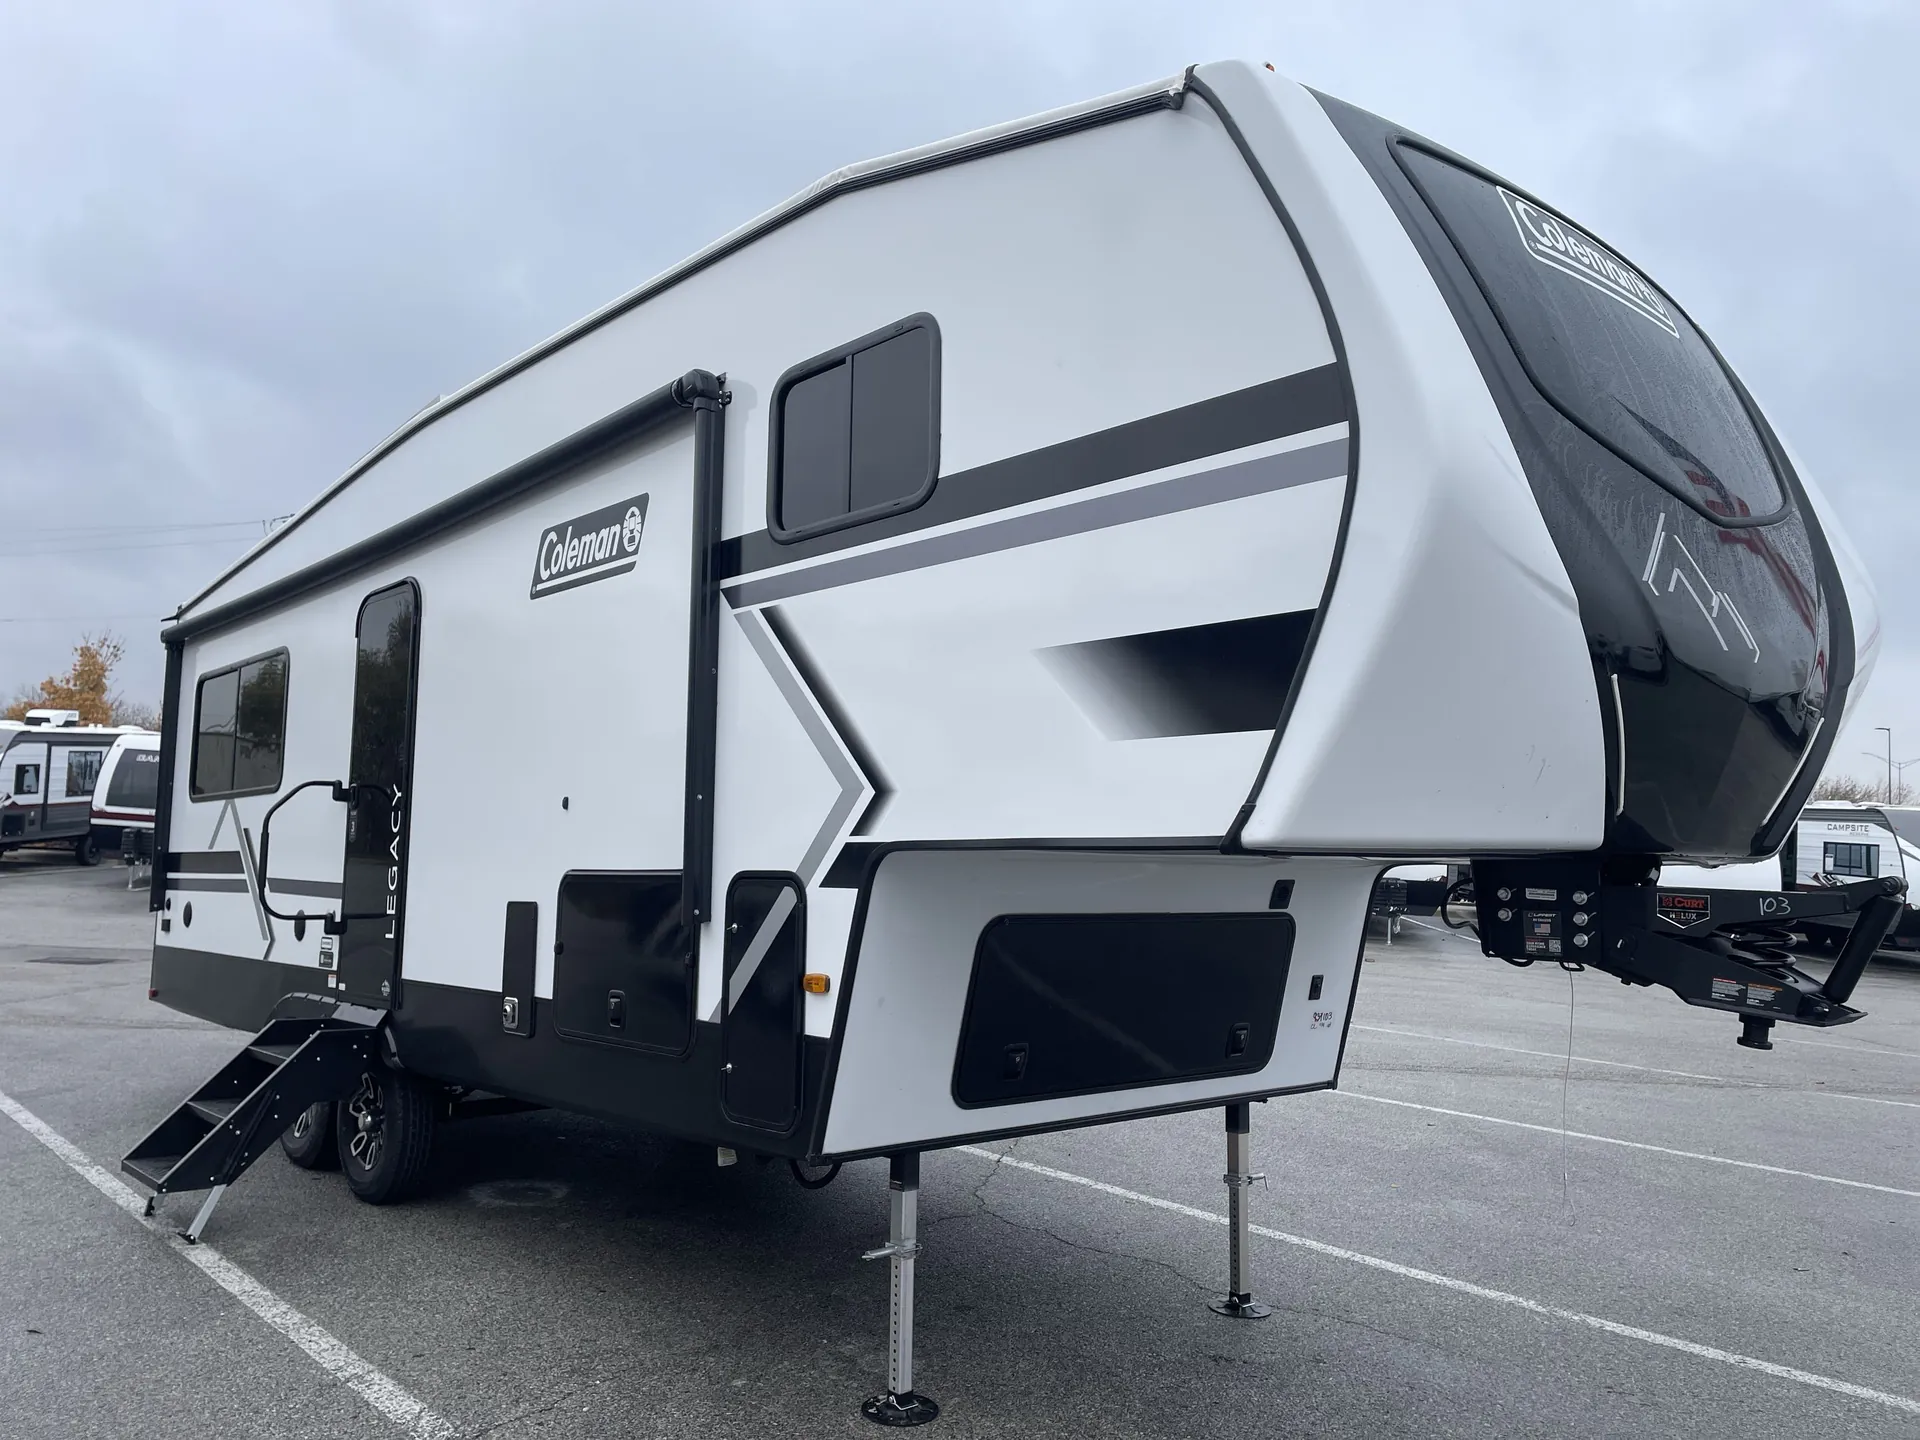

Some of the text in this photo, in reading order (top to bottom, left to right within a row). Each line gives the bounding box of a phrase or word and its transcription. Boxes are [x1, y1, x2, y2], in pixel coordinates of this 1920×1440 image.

[1515, 200, 1645, 299] Coleman
[539, 525, 621, 581] Coleman
[1827, 823, 1870, 832] CAMPSITE
[385, 783, 402, 939] LEGACY
[1759, 896, 1791, 916] 103
